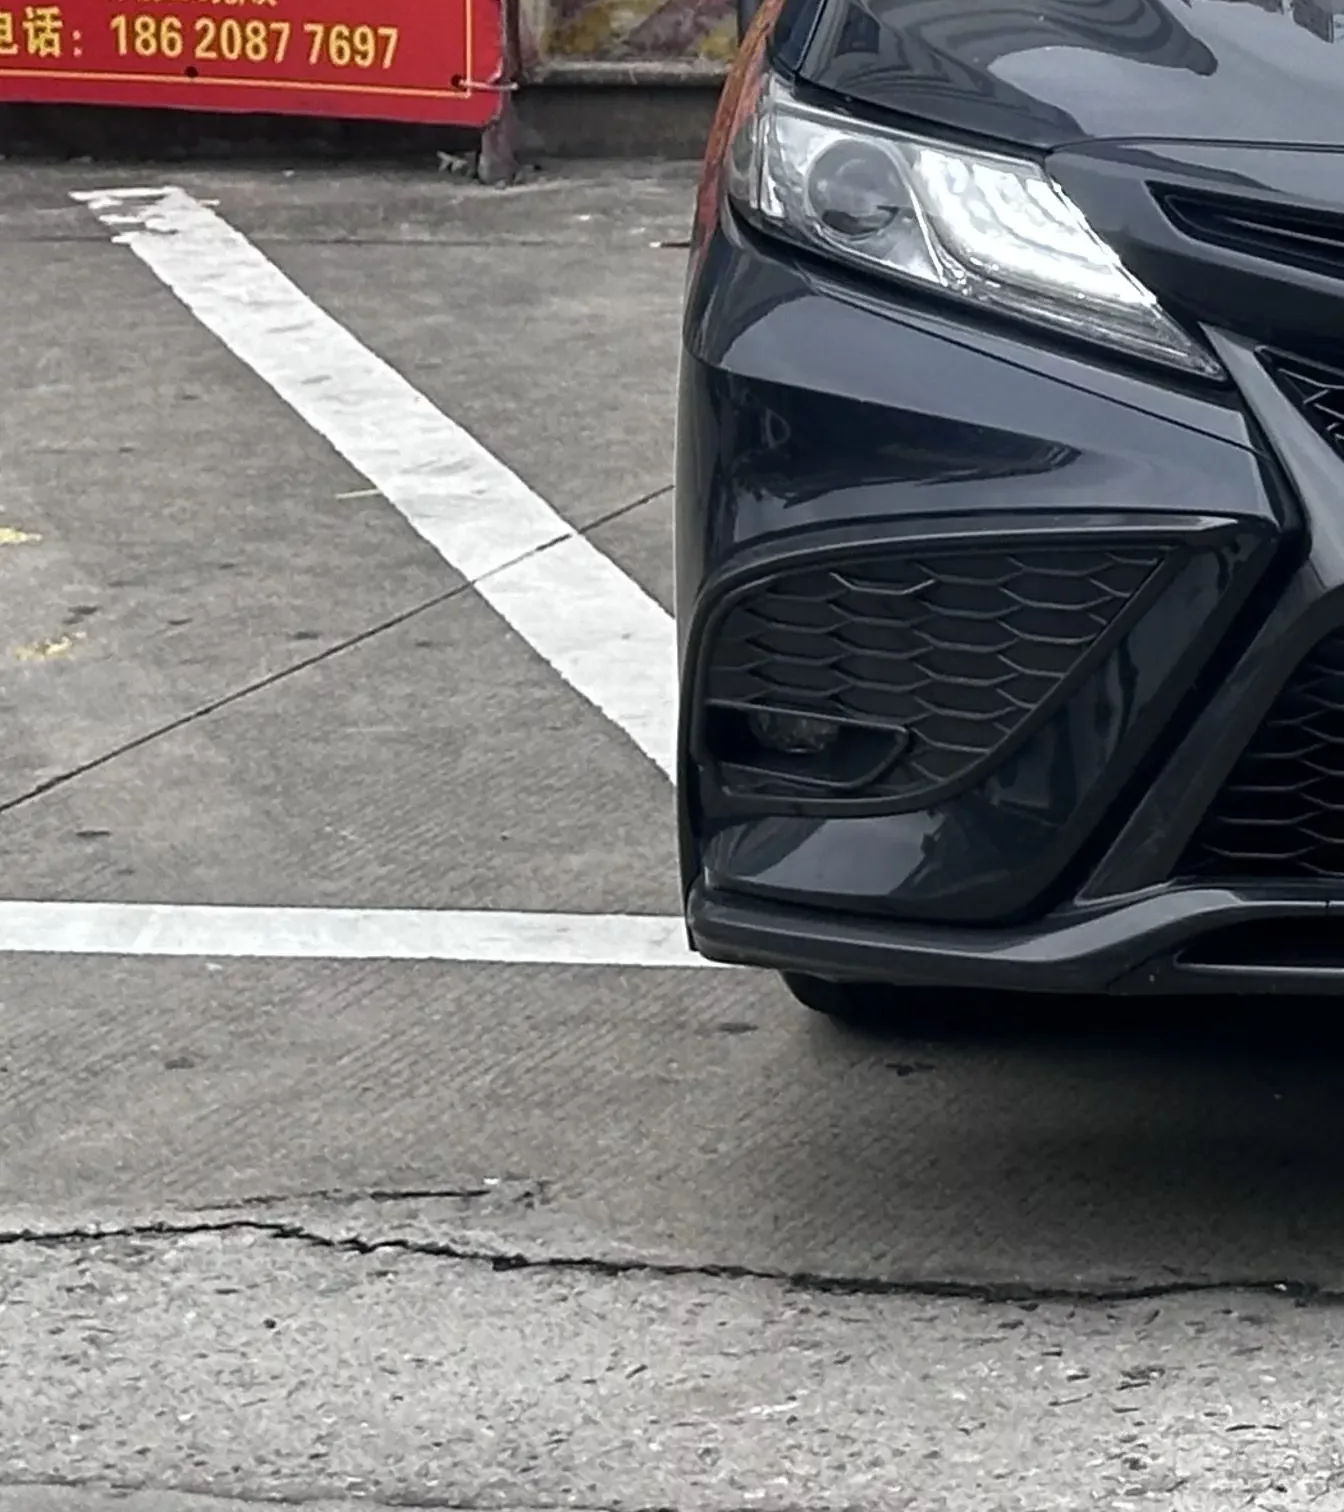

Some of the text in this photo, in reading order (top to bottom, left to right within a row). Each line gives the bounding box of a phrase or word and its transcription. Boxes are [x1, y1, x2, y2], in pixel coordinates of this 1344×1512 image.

[110, 14, 183, 59] 186
[194, 16, 291, 65] 2087
[303, 22, 400, 70] 7697
